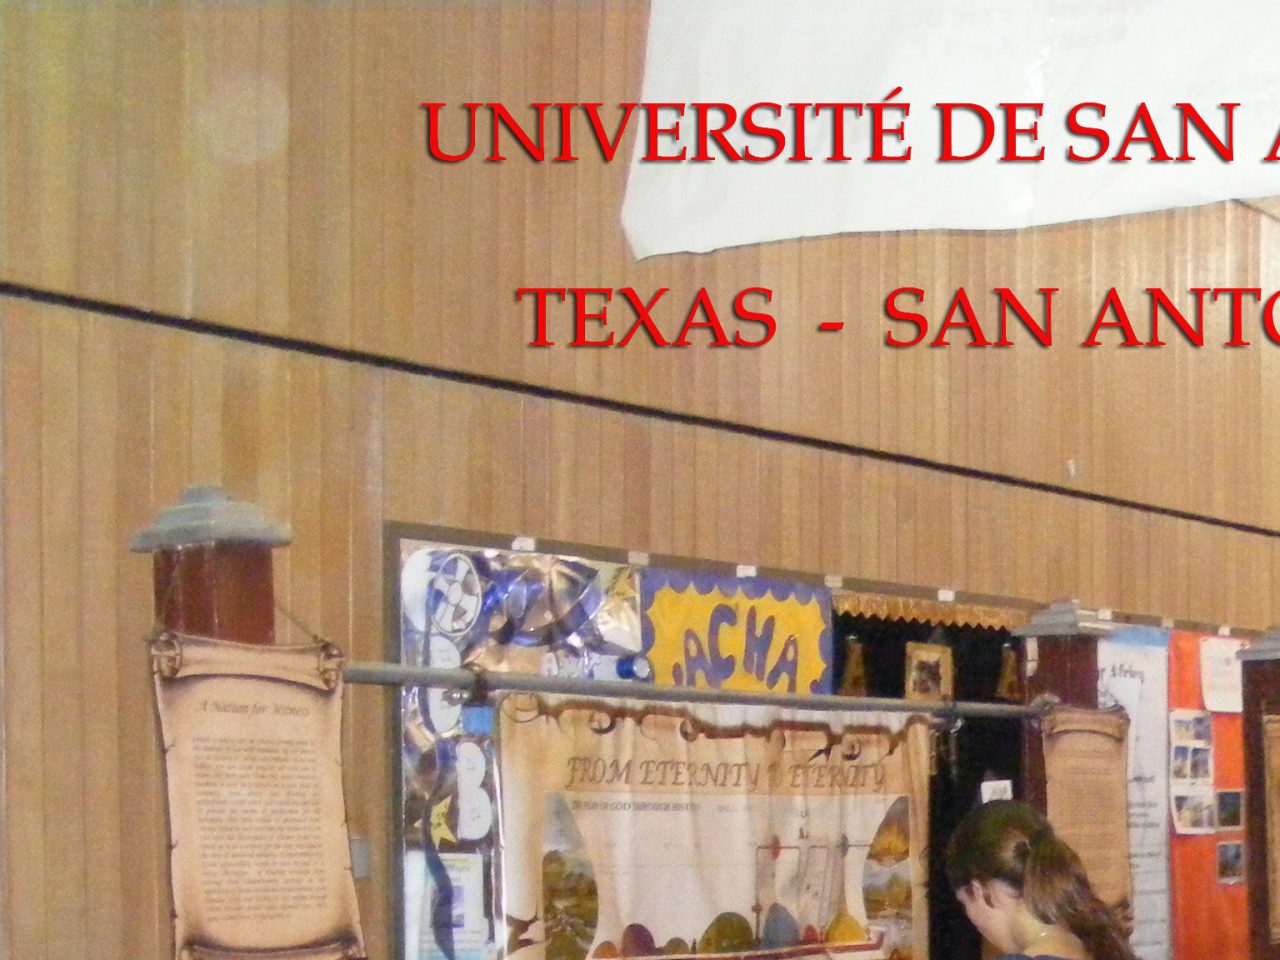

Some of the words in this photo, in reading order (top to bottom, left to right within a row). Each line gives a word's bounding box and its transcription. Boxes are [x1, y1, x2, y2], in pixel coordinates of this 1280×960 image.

[673, 603, 820, 693] ACHA
[566, 756, 632, 790] FROM
[639, 759, 759, 792] ETERNITY
[789, 763, 886, 793] ETERNITY
[610, 803, 631, 811] GOD
